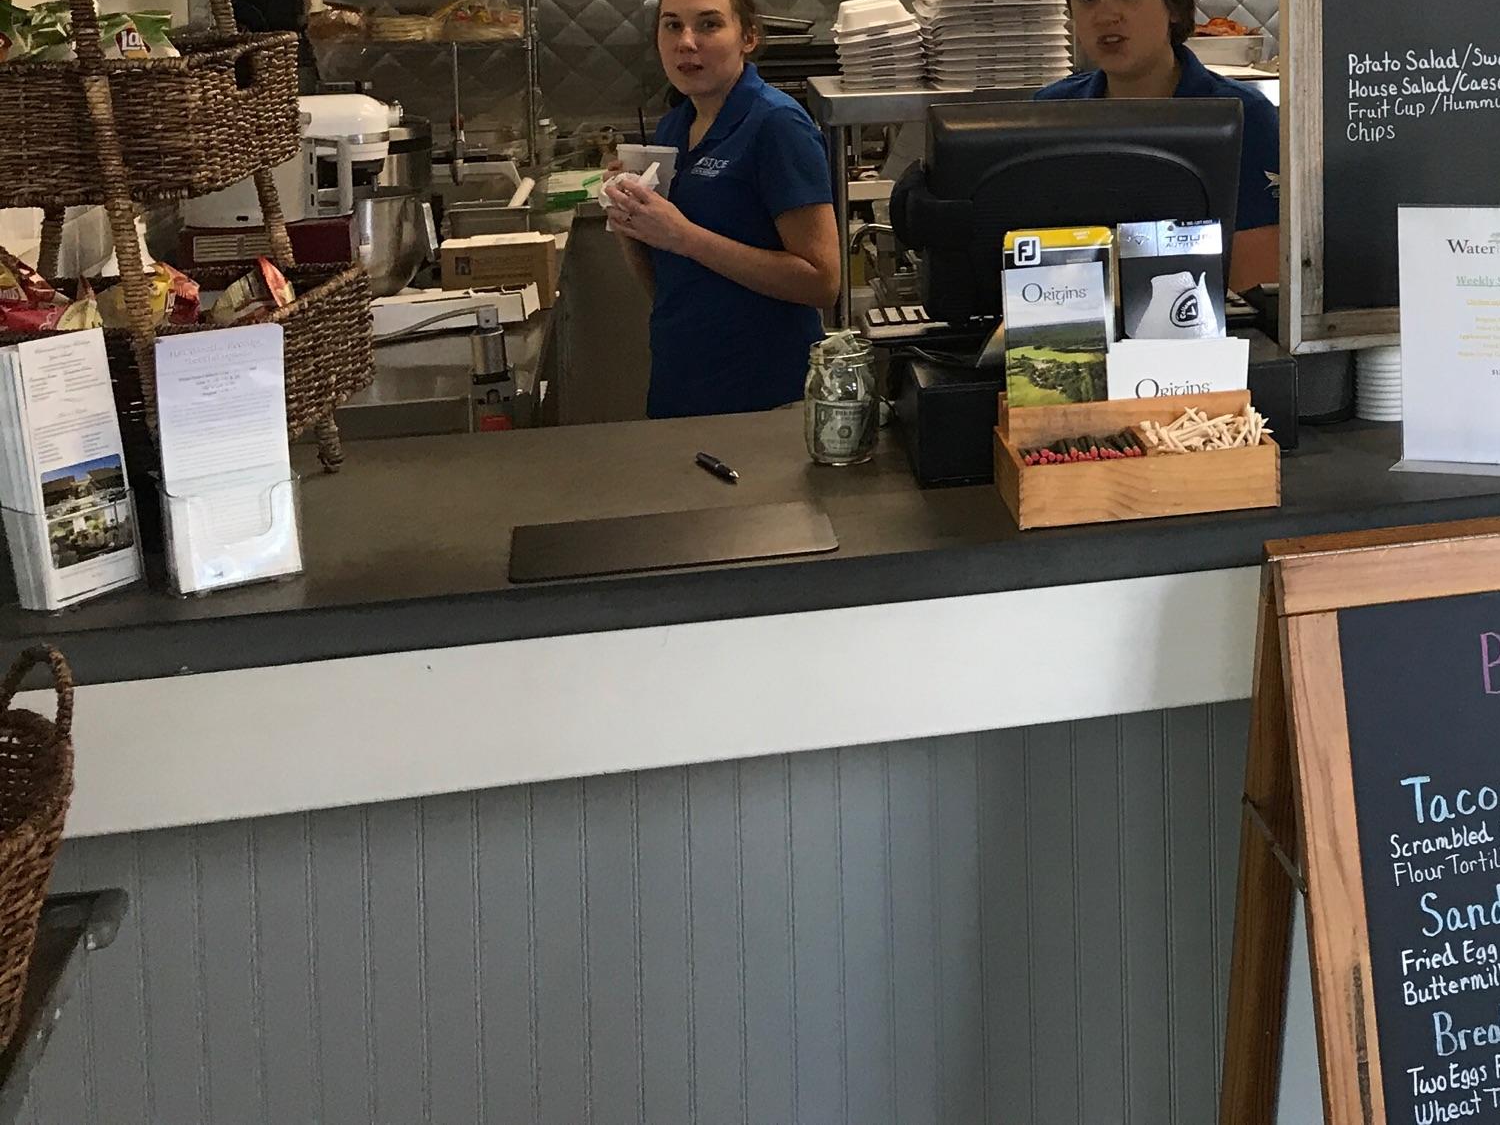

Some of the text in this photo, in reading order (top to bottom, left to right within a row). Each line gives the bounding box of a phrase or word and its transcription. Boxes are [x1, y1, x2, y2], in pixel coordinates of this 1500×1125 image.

[1346, 121, 1395, 142] Chips
[1018, 240, 1036, 262] FJ
[1456, 276, 1494, 287] Weekly
[1022, 282, 1087, 305] Origins
[1393, 862, 1444, 887] Flour
